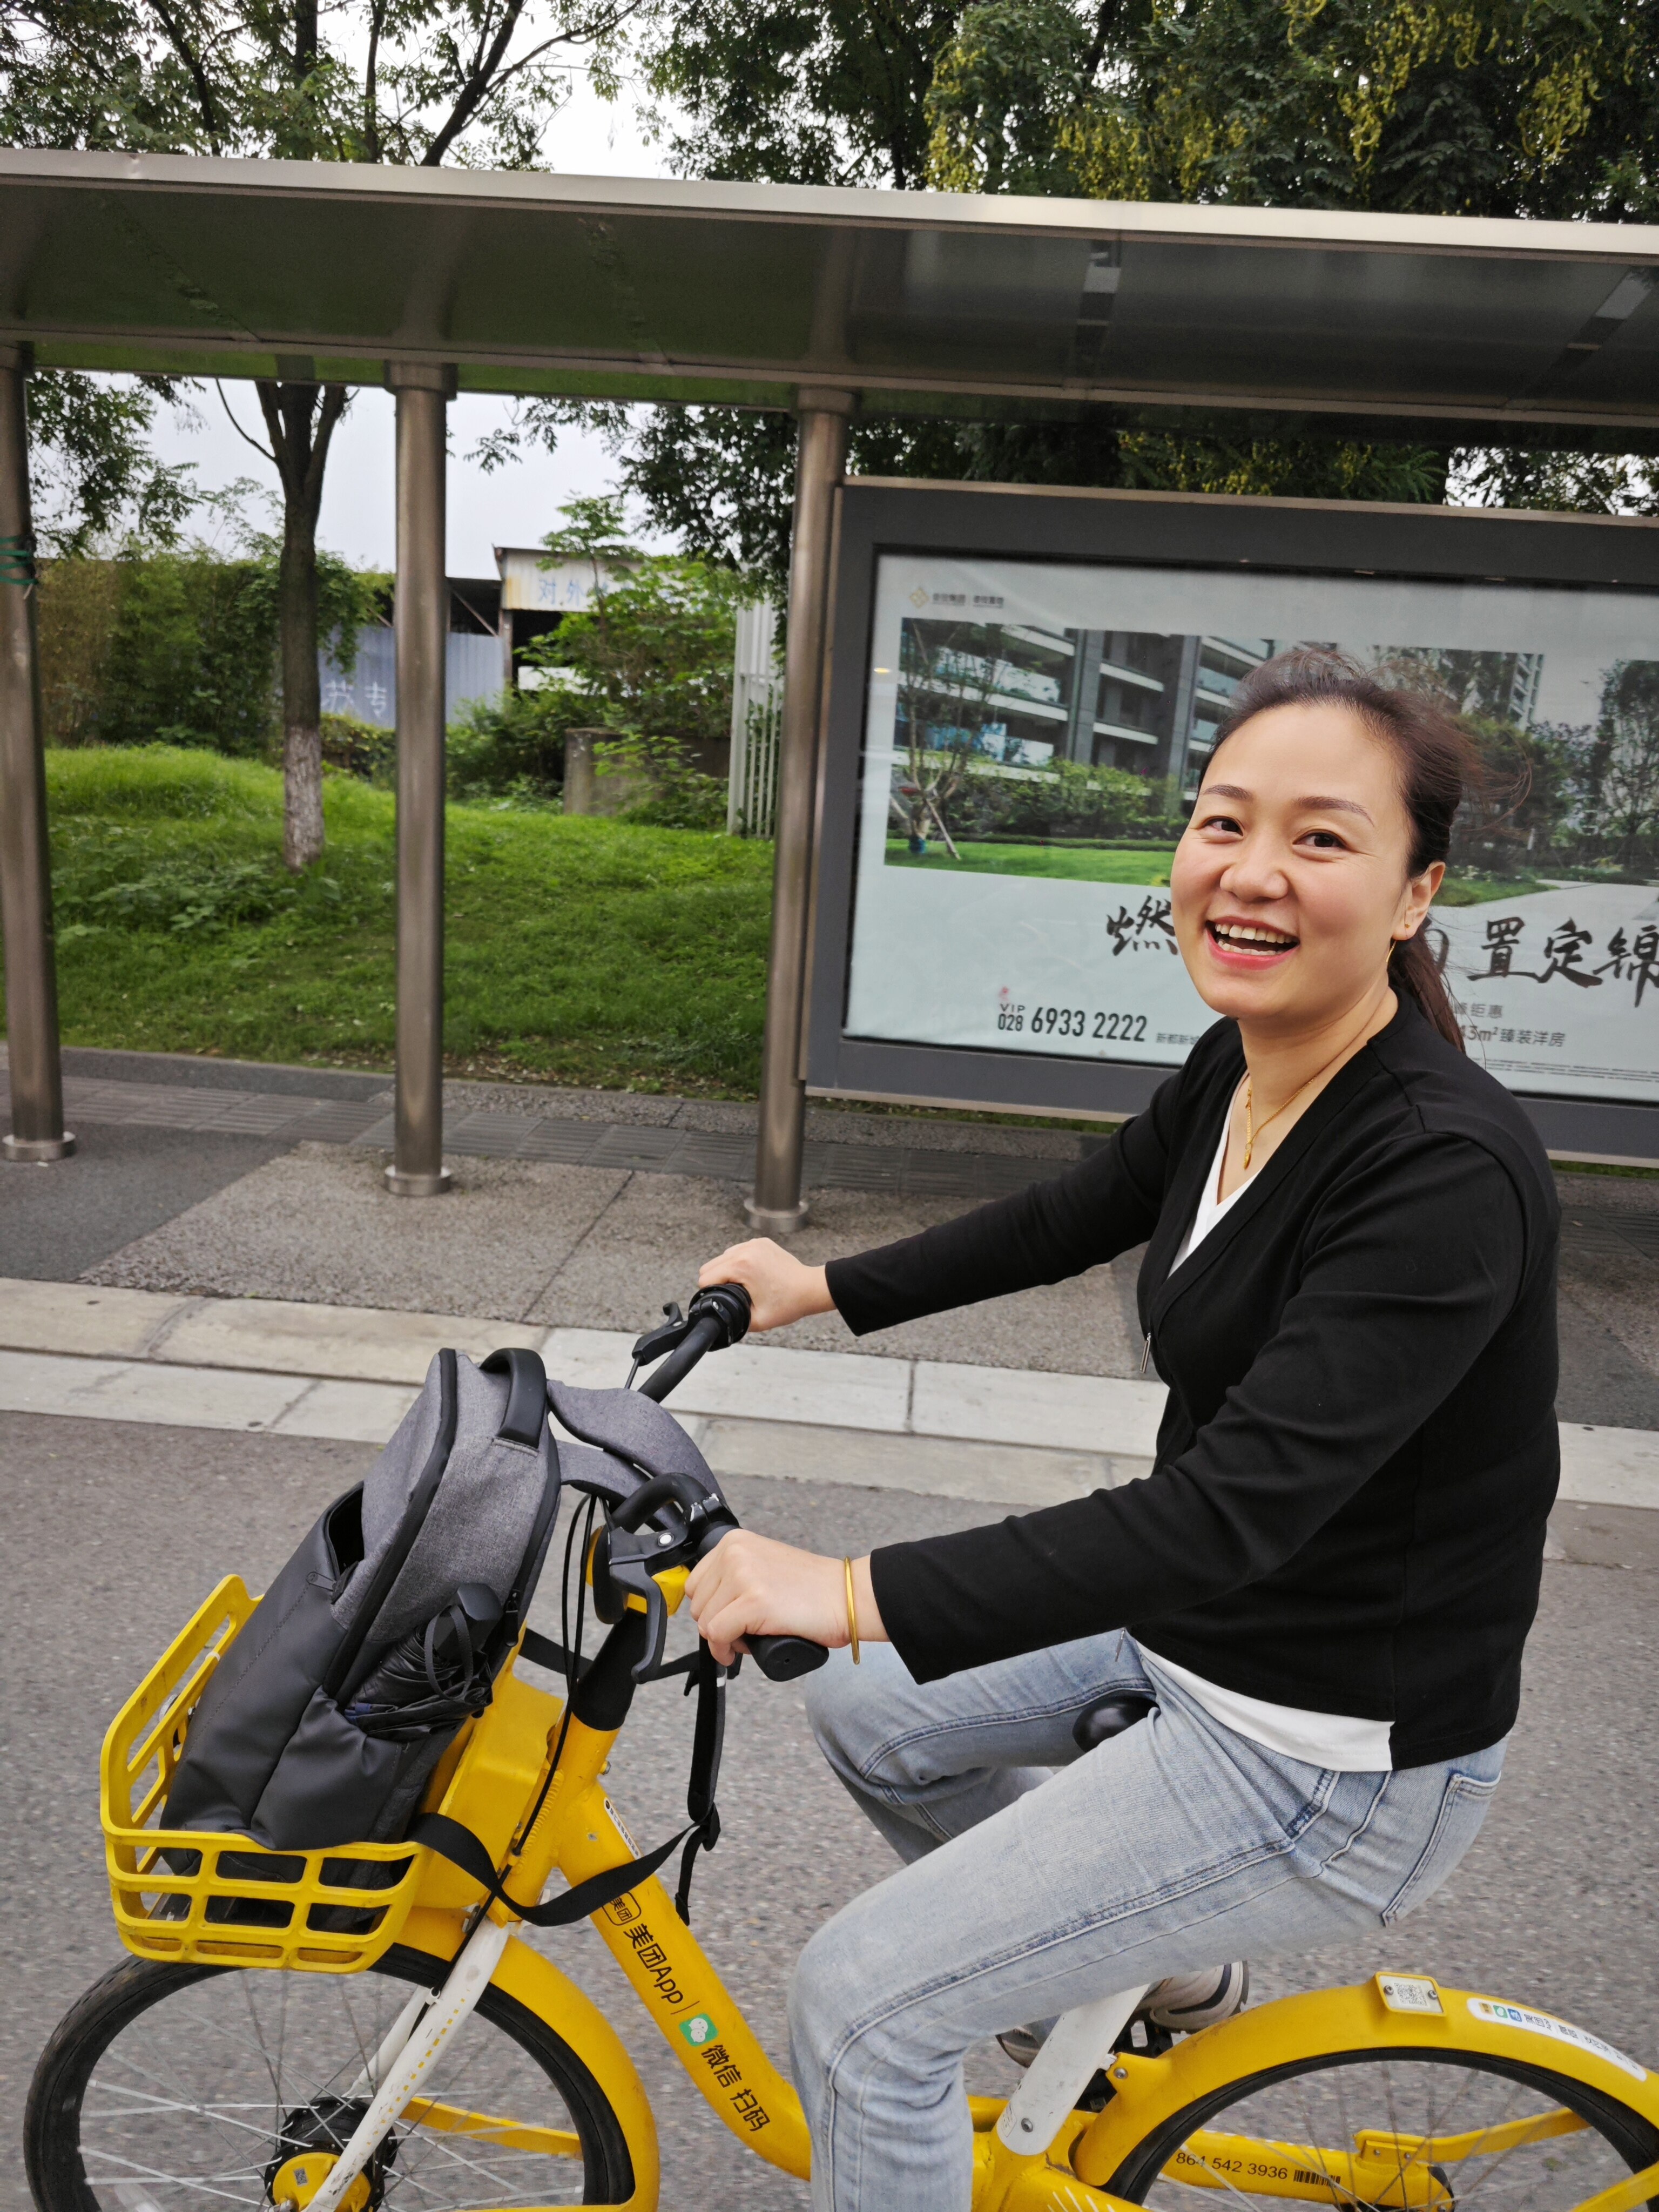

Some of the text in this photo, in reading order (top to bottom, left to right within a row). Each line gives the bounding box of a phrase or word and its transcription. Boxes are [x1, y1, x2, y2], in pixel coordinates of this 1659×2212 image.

[999, 1003, 1026, 1013] VIP
[998, 1007, 1148, 1042] 028 6933 2222
[610, 1896, 632, 1922] 美团
[623, 1923, 771, 2132] 美团App 微信 扫码
[1212, 2157, 1243, 2173] 542
[1247, 2163, 1287, 2180] 3936
